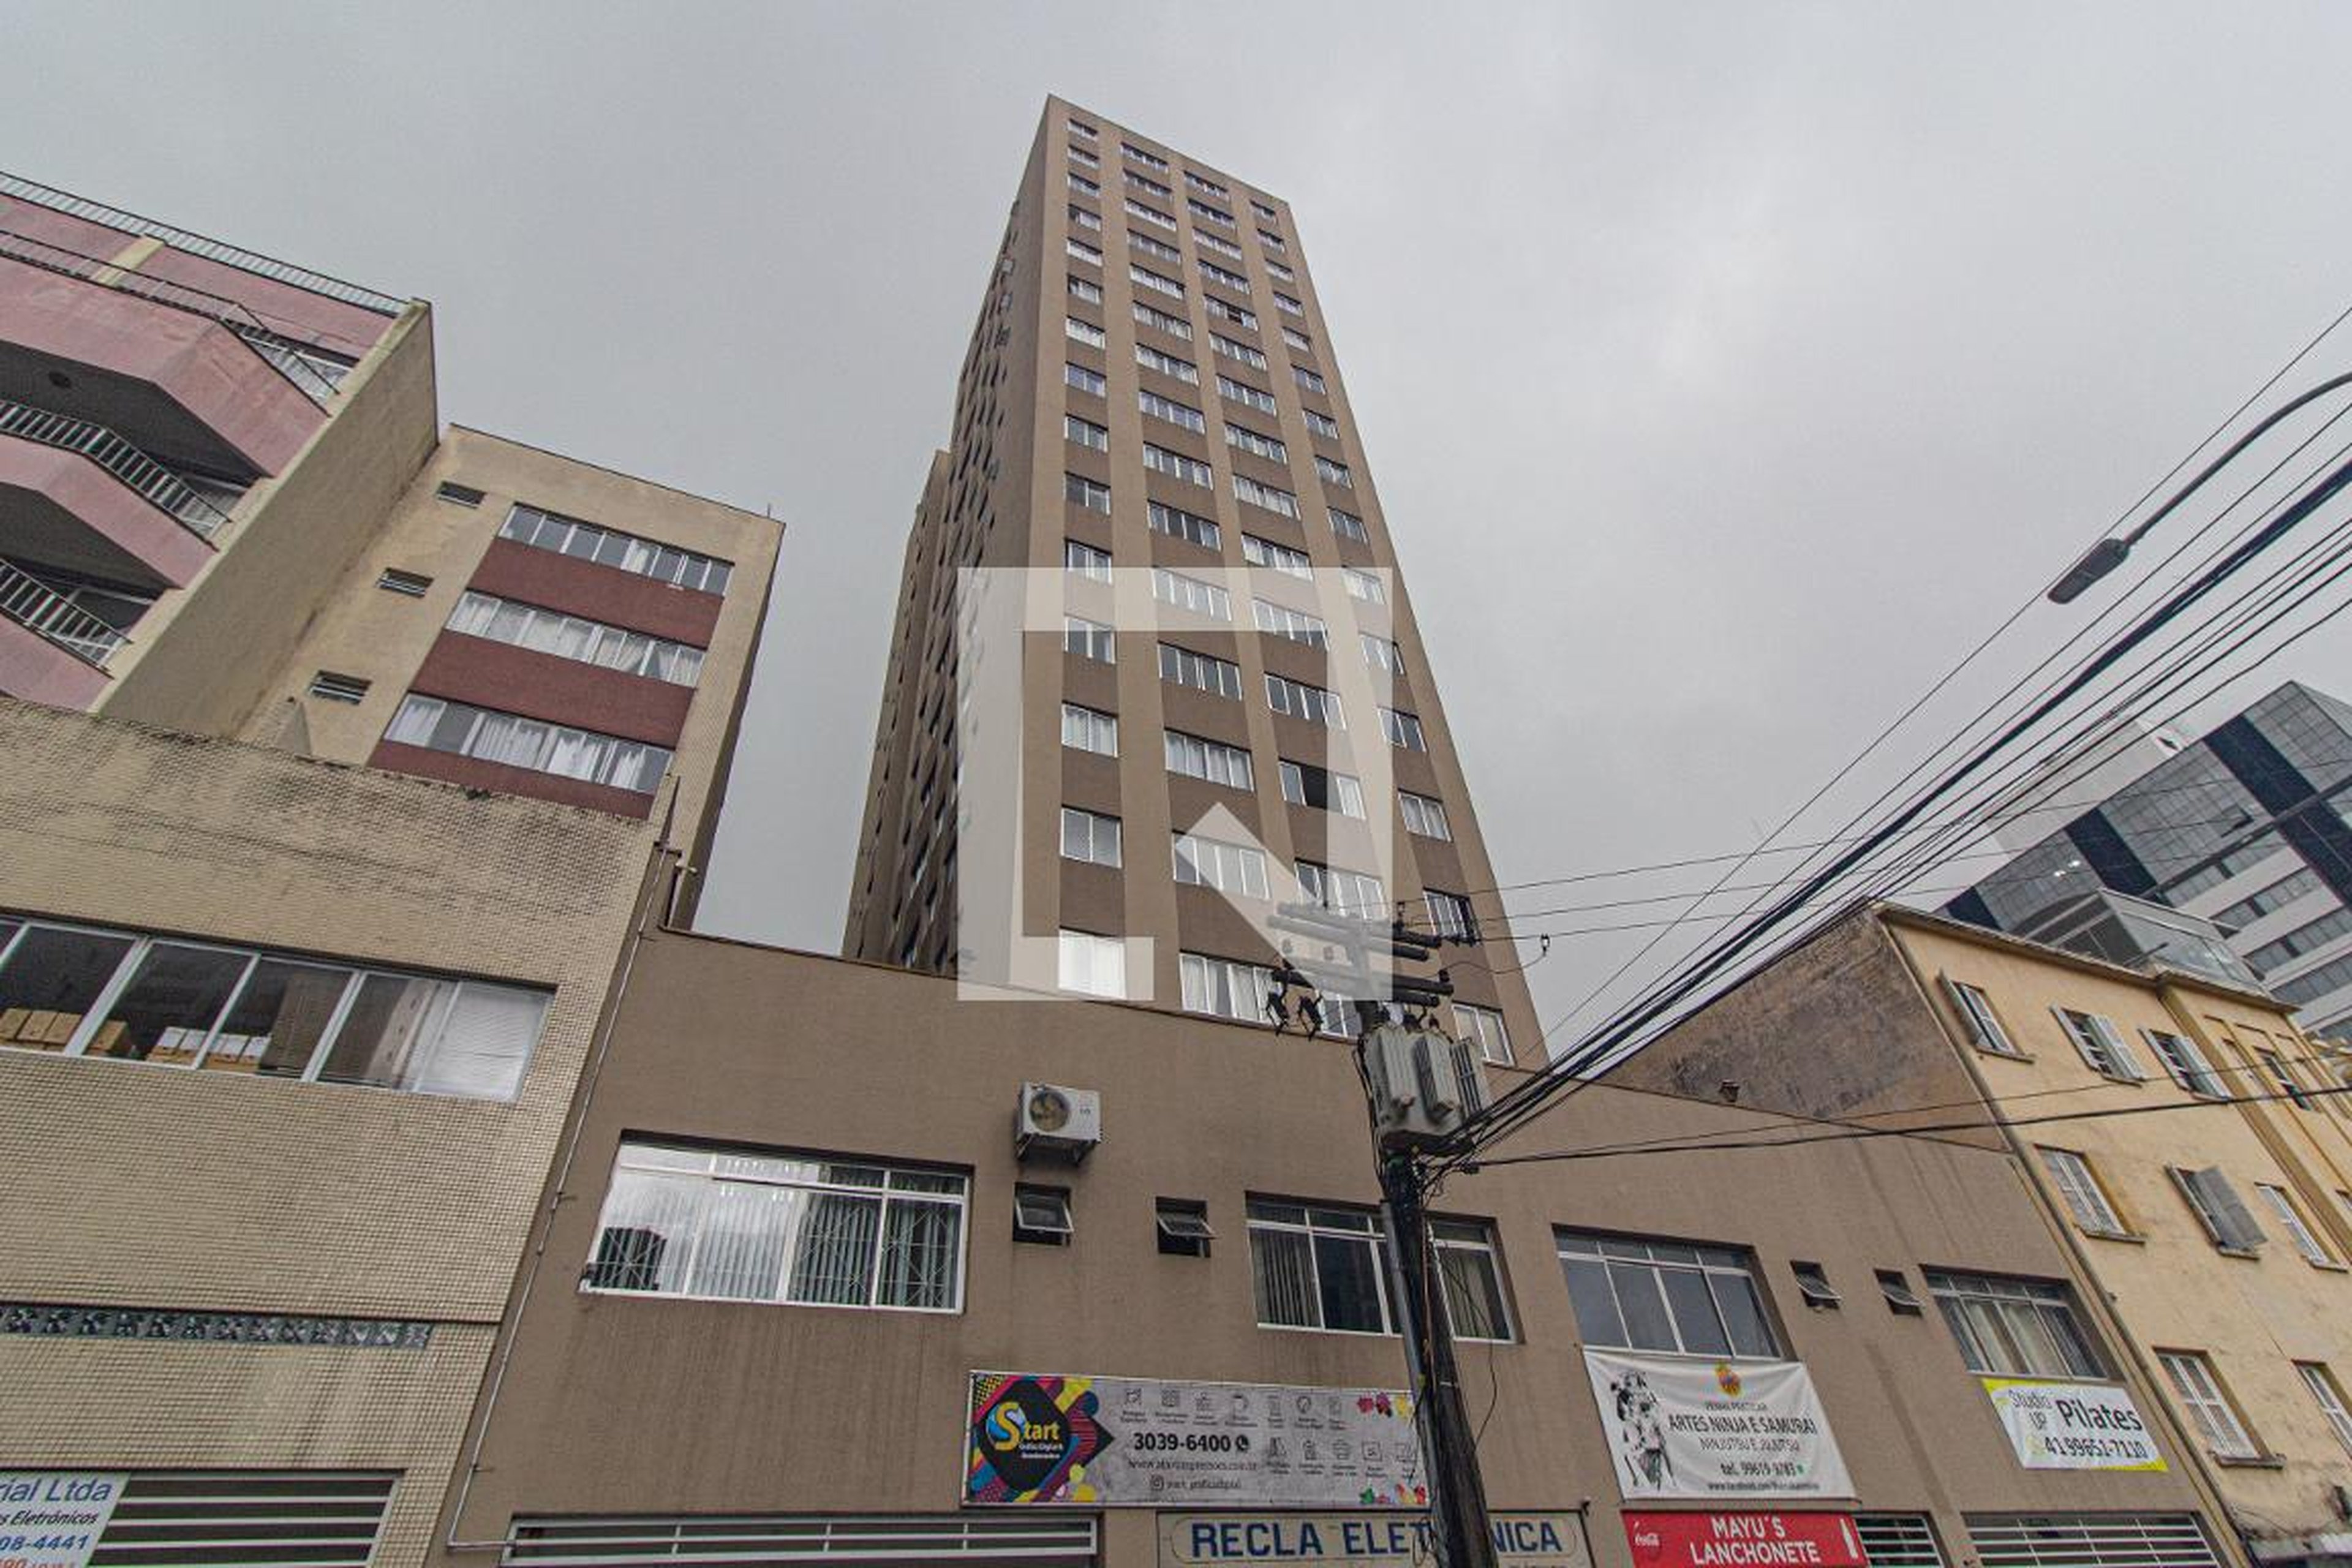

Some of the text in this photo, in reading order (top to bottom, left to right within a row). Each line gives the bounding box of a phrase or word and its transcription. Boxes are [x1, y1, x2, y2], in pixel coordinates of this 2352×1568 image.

[995, 1401, 1060, 1450] Start
[1668, 1414, 1817, 1434] ARTES NINJA E SAMURAI
[2056, 1399, 2143, 1431] Pilates
[1134, 1433, 1231, 1452] 3039-6400
[2045, 1437, 2067, 1455] 41
[46, 1479, 112, 1501] Ltda
[1192, 1523, 1323, 1557] RECLA
[1691, 1541, 1822, 1564] LANCHONETE
